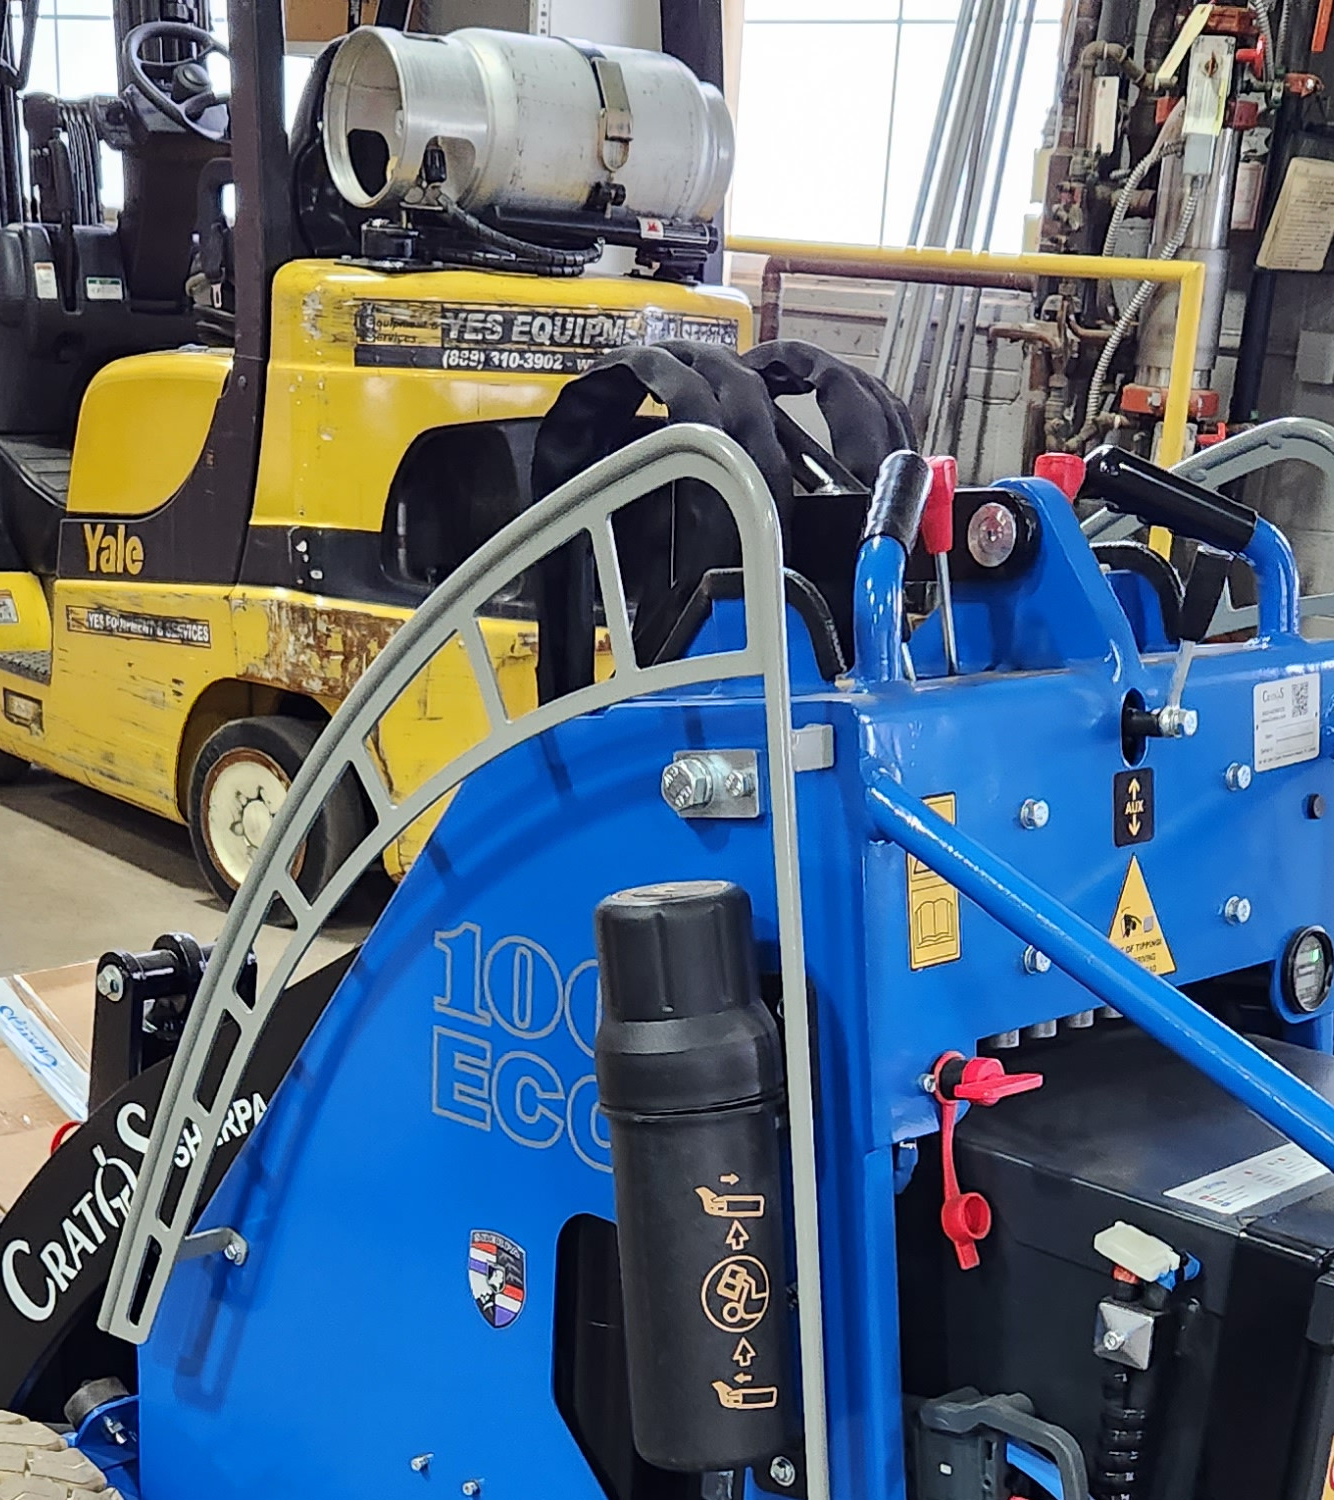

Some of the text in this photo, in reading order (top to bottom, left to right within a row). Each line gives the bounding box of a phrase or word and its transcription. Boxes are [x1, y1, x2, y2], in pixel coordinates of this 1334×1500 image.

[444, 312, 504, 341] YES
[490, 351, 564, 370] 310-3902
[83, 523, 144, 576] Yale
[88, 612, 105, 629] YES
[1124, 799, 1145, 815] AUX
[174, 1092, 268, 1169] SHRPA
